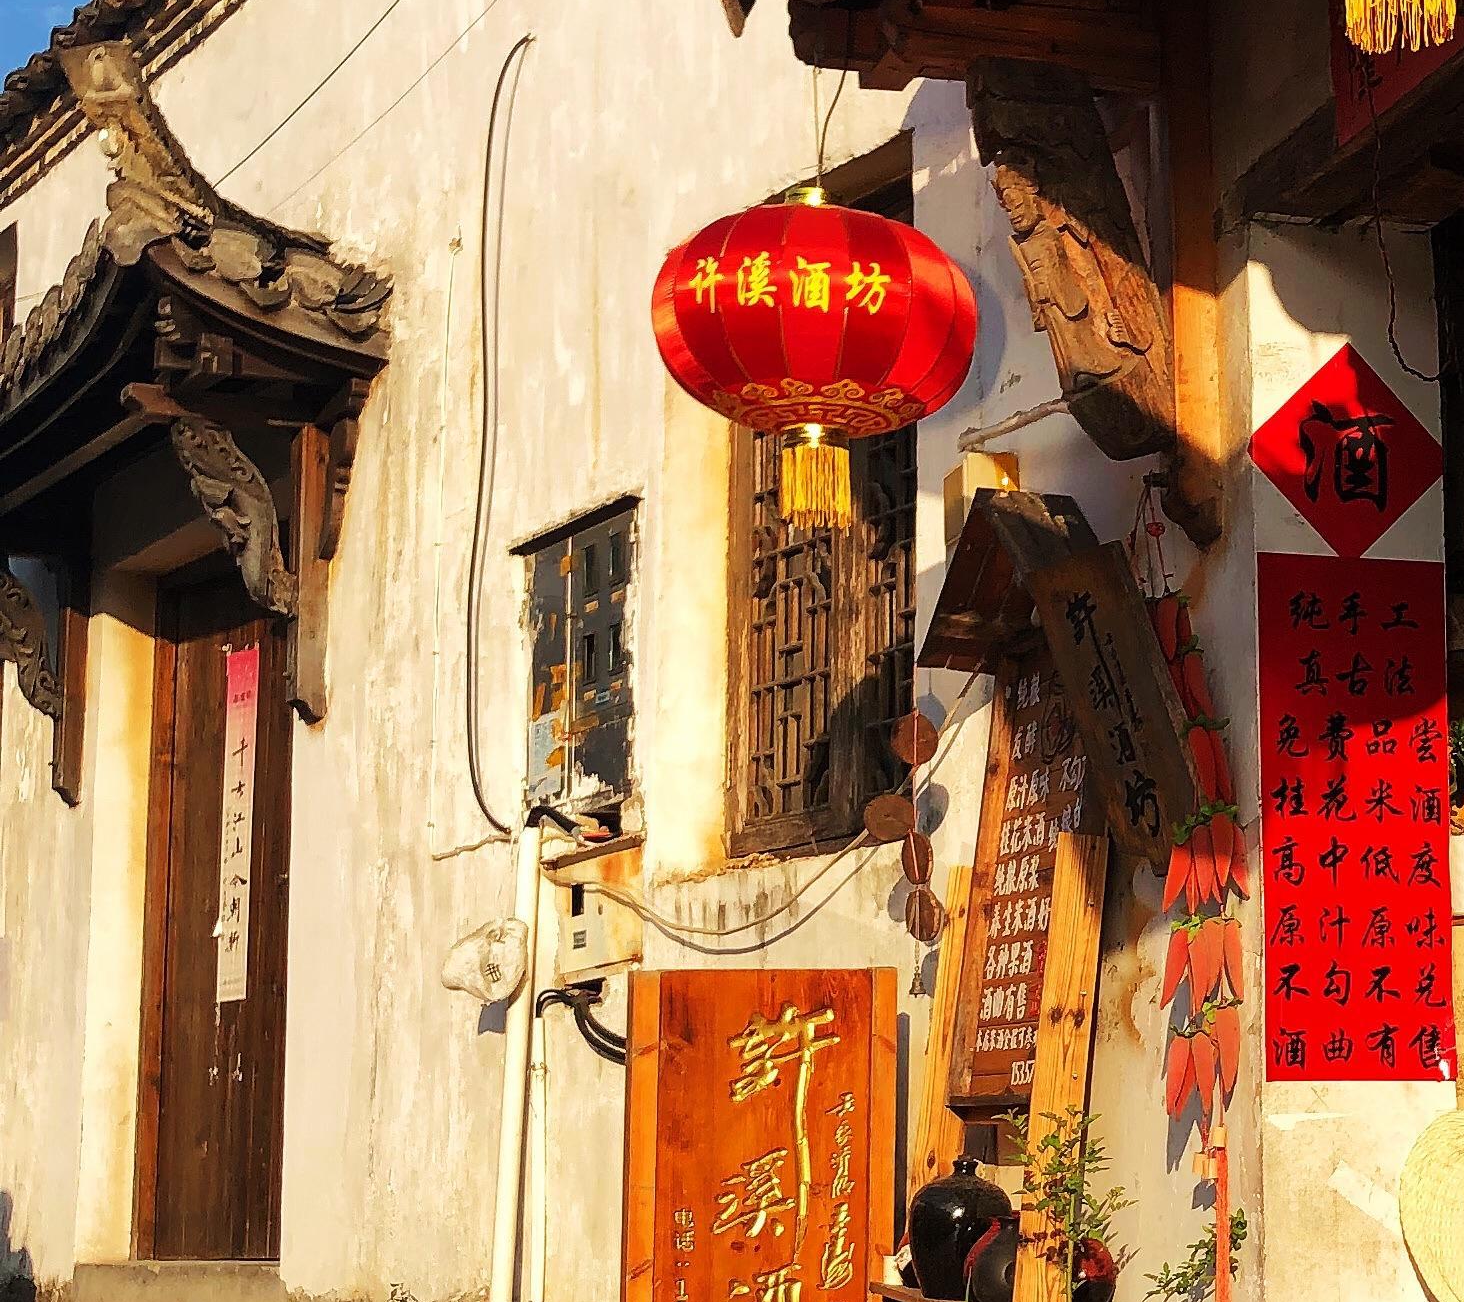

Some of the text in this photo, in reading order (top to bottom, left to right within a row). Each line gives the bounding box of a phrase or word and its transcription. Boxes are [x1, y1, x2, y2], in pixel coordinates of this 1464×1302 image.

[688, 251, 892, 315] 许溪酒坊
[1298, 400, 1394, 512] 酒
[1288, 590, 1419, 635] 纯手工
[1295, 648, 1416, 697] 真古法
[1271, 774, 1444, 825] 桂花米酒
[1000, 811, 1046, 857] 桂花米酒
[1271, 836, 1442, 888] 高中低度
[1269, 903, 1446, 949] 原汁原味
[1272, 960, 1447, 1007] 不勾不兑
[1272, 1022, 1447, 1070] 酒曲有售
